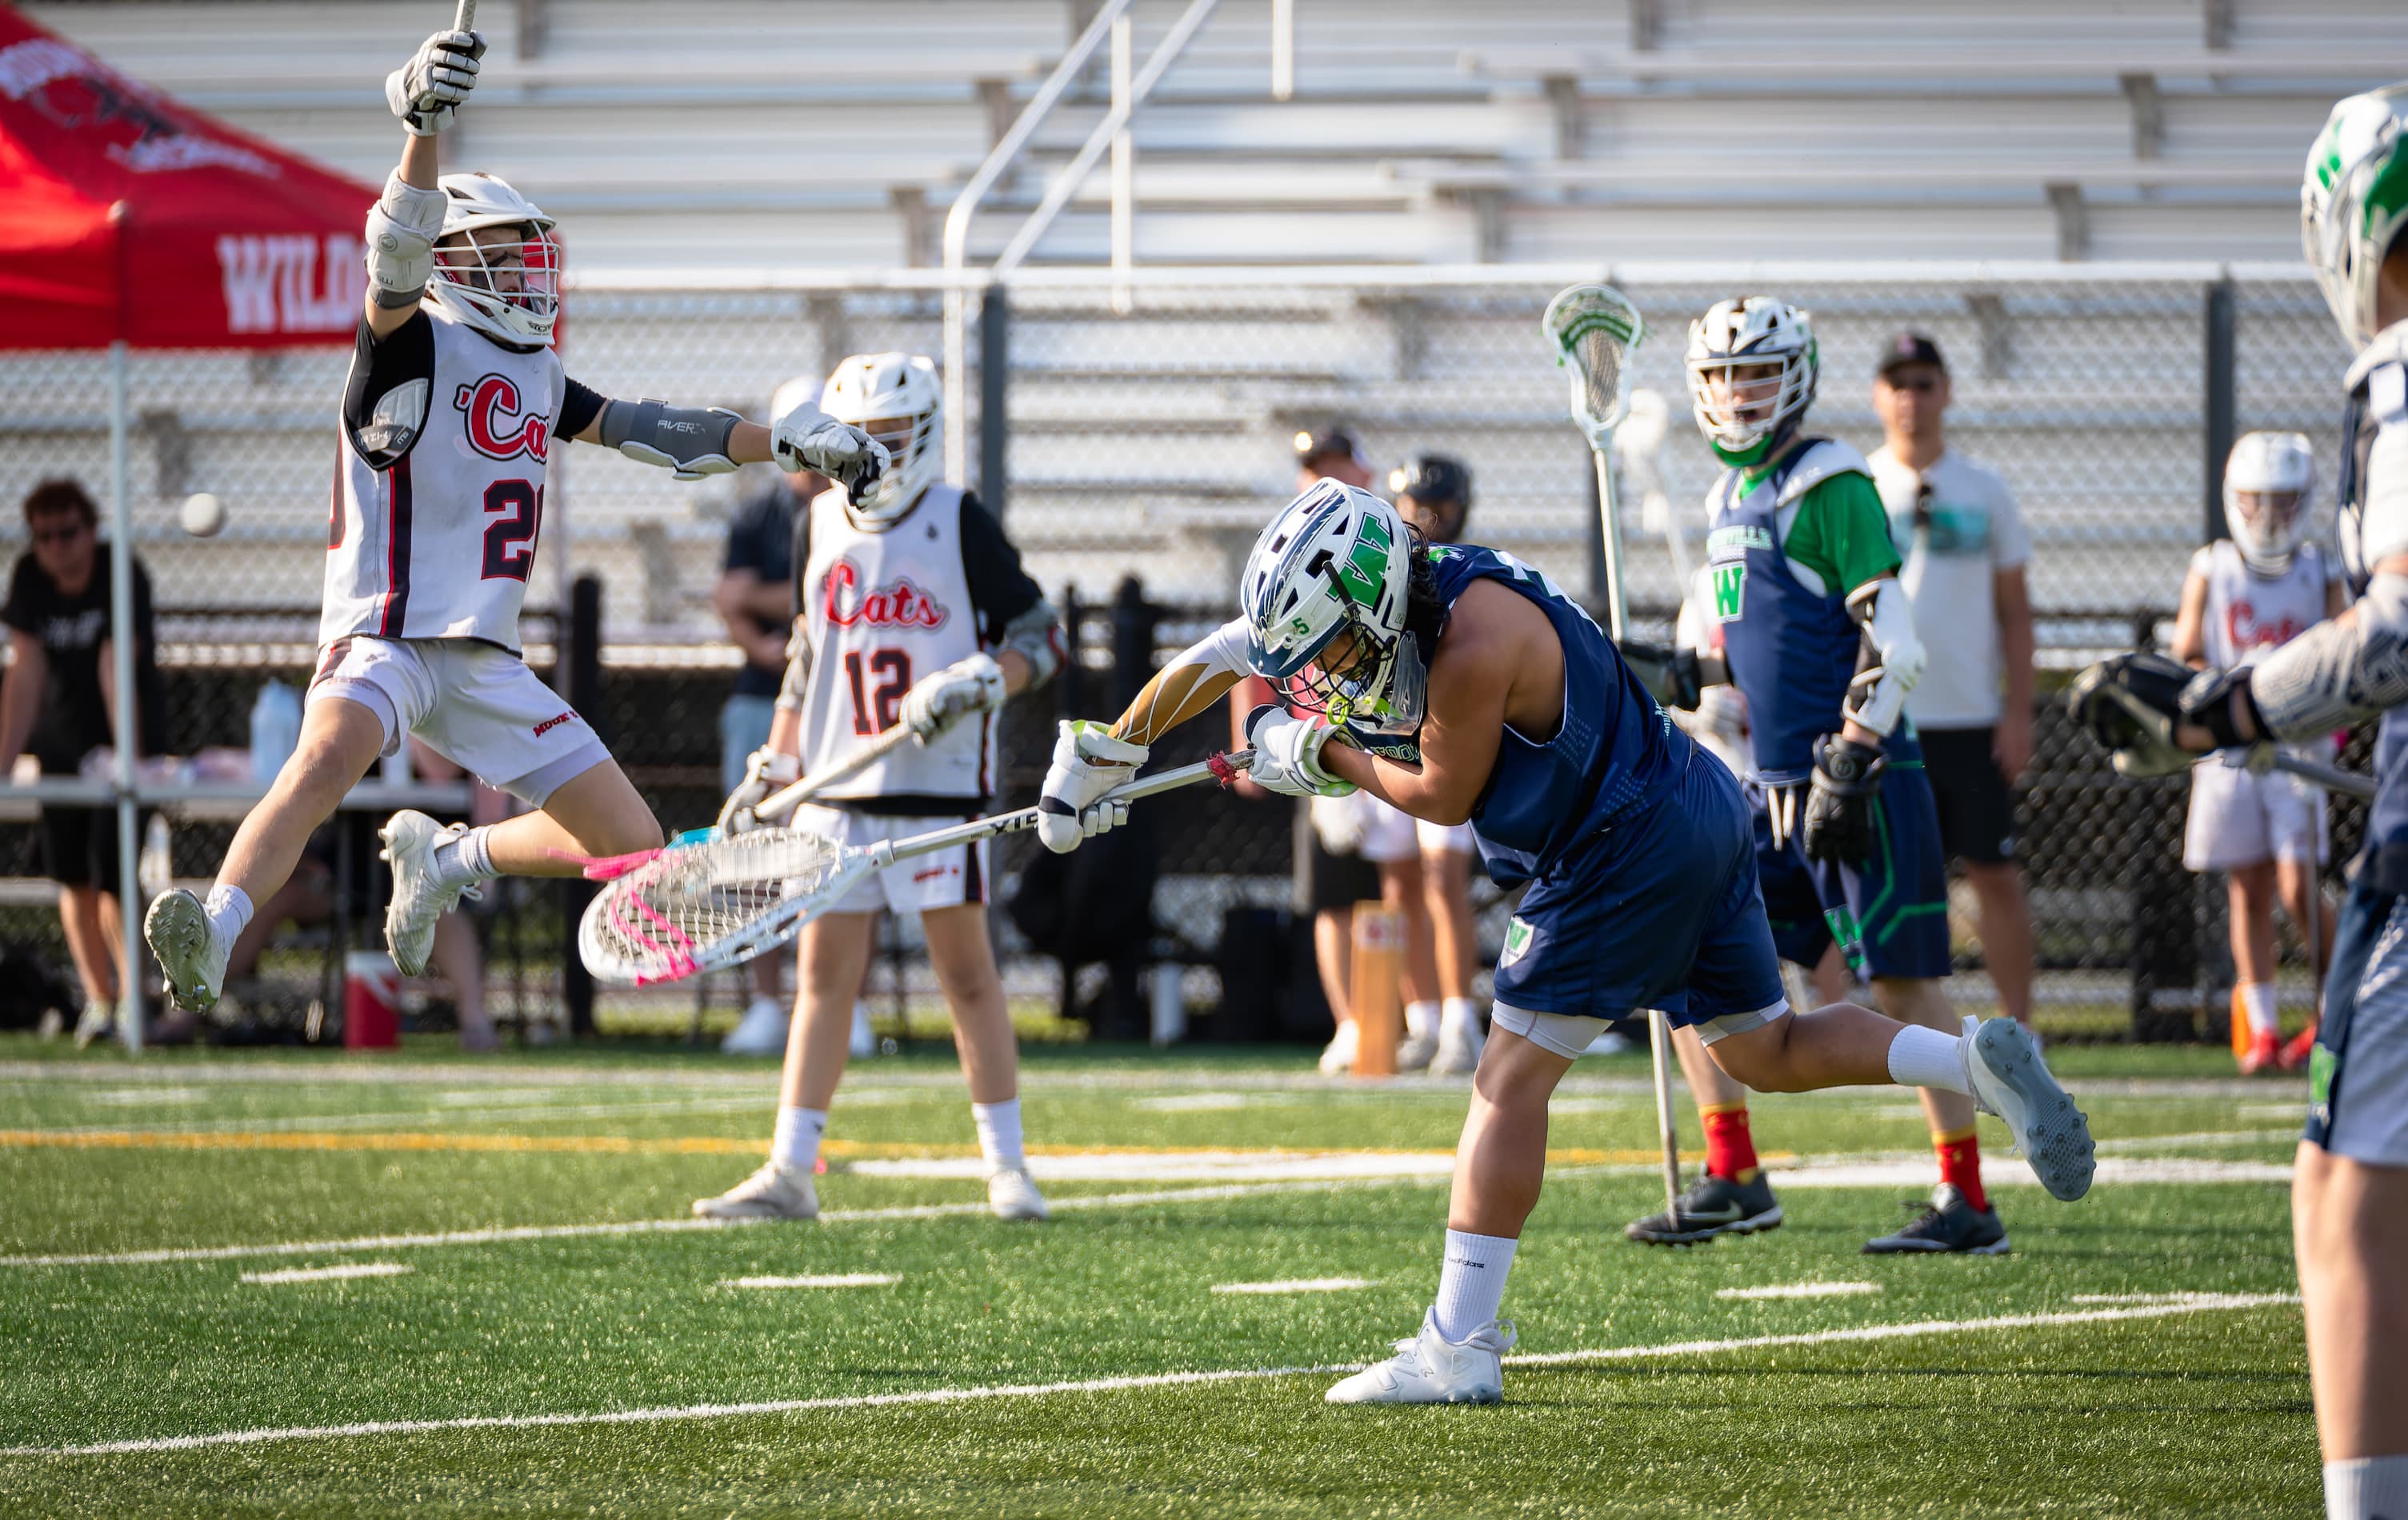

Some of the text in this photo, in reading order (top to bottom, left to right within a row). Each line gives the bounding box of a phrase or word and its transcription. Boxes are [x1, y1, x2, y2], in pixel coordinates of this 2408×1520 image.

[216, 234, 368, 333] WILD
[481, 478, 544, 582] 2
[1325, 512, 1390, 610] W
[822, 558, 951, 632] Cats
[1291, 617, 1310, 635] 5
[1712, 562, 1747, 622] W
[844, 649, 911, 735] 12
